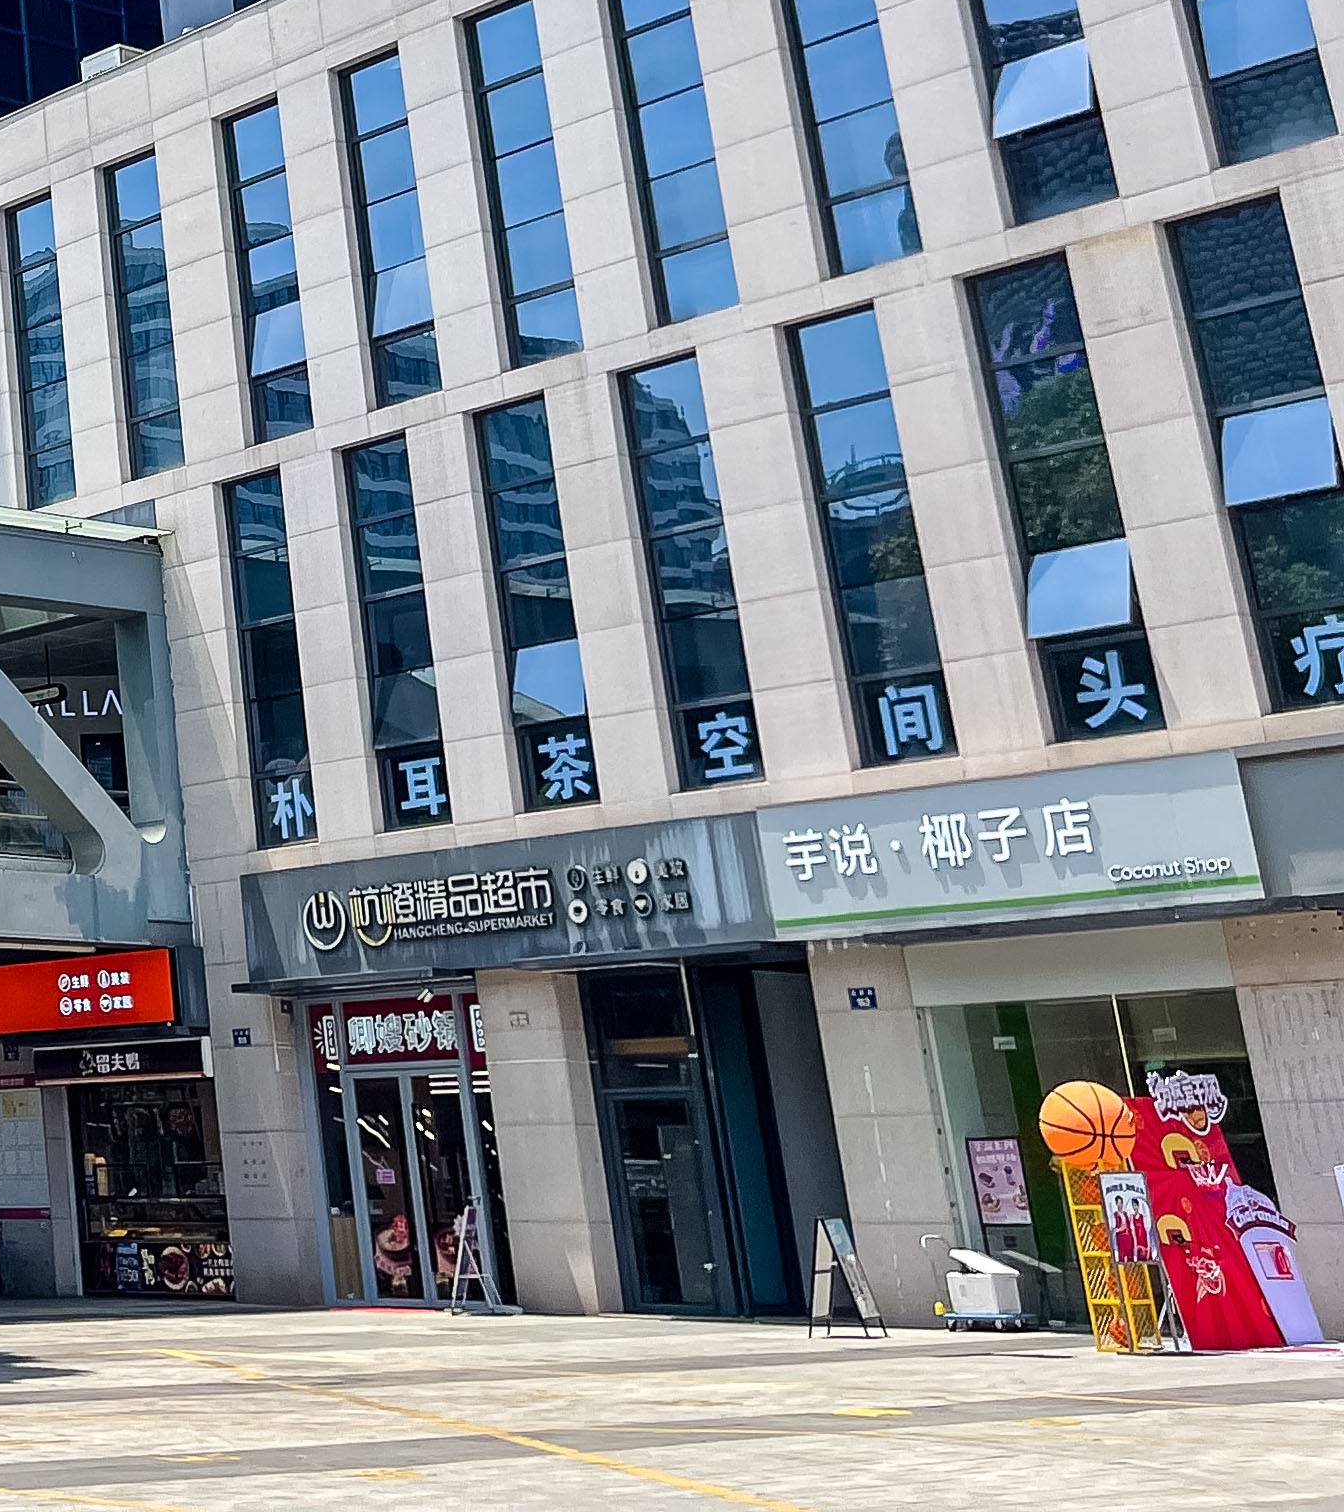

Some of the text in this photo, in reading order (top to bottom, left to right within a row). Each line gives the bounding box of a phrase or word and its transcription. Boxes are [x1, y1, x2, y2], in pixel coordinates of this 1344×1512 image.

[1108, 854, 1231, 882] Coconut Shop
[348, 868, 552, 928] 杭橙精品超市
[96, 1052, 140, 1073] 留夫鸭
